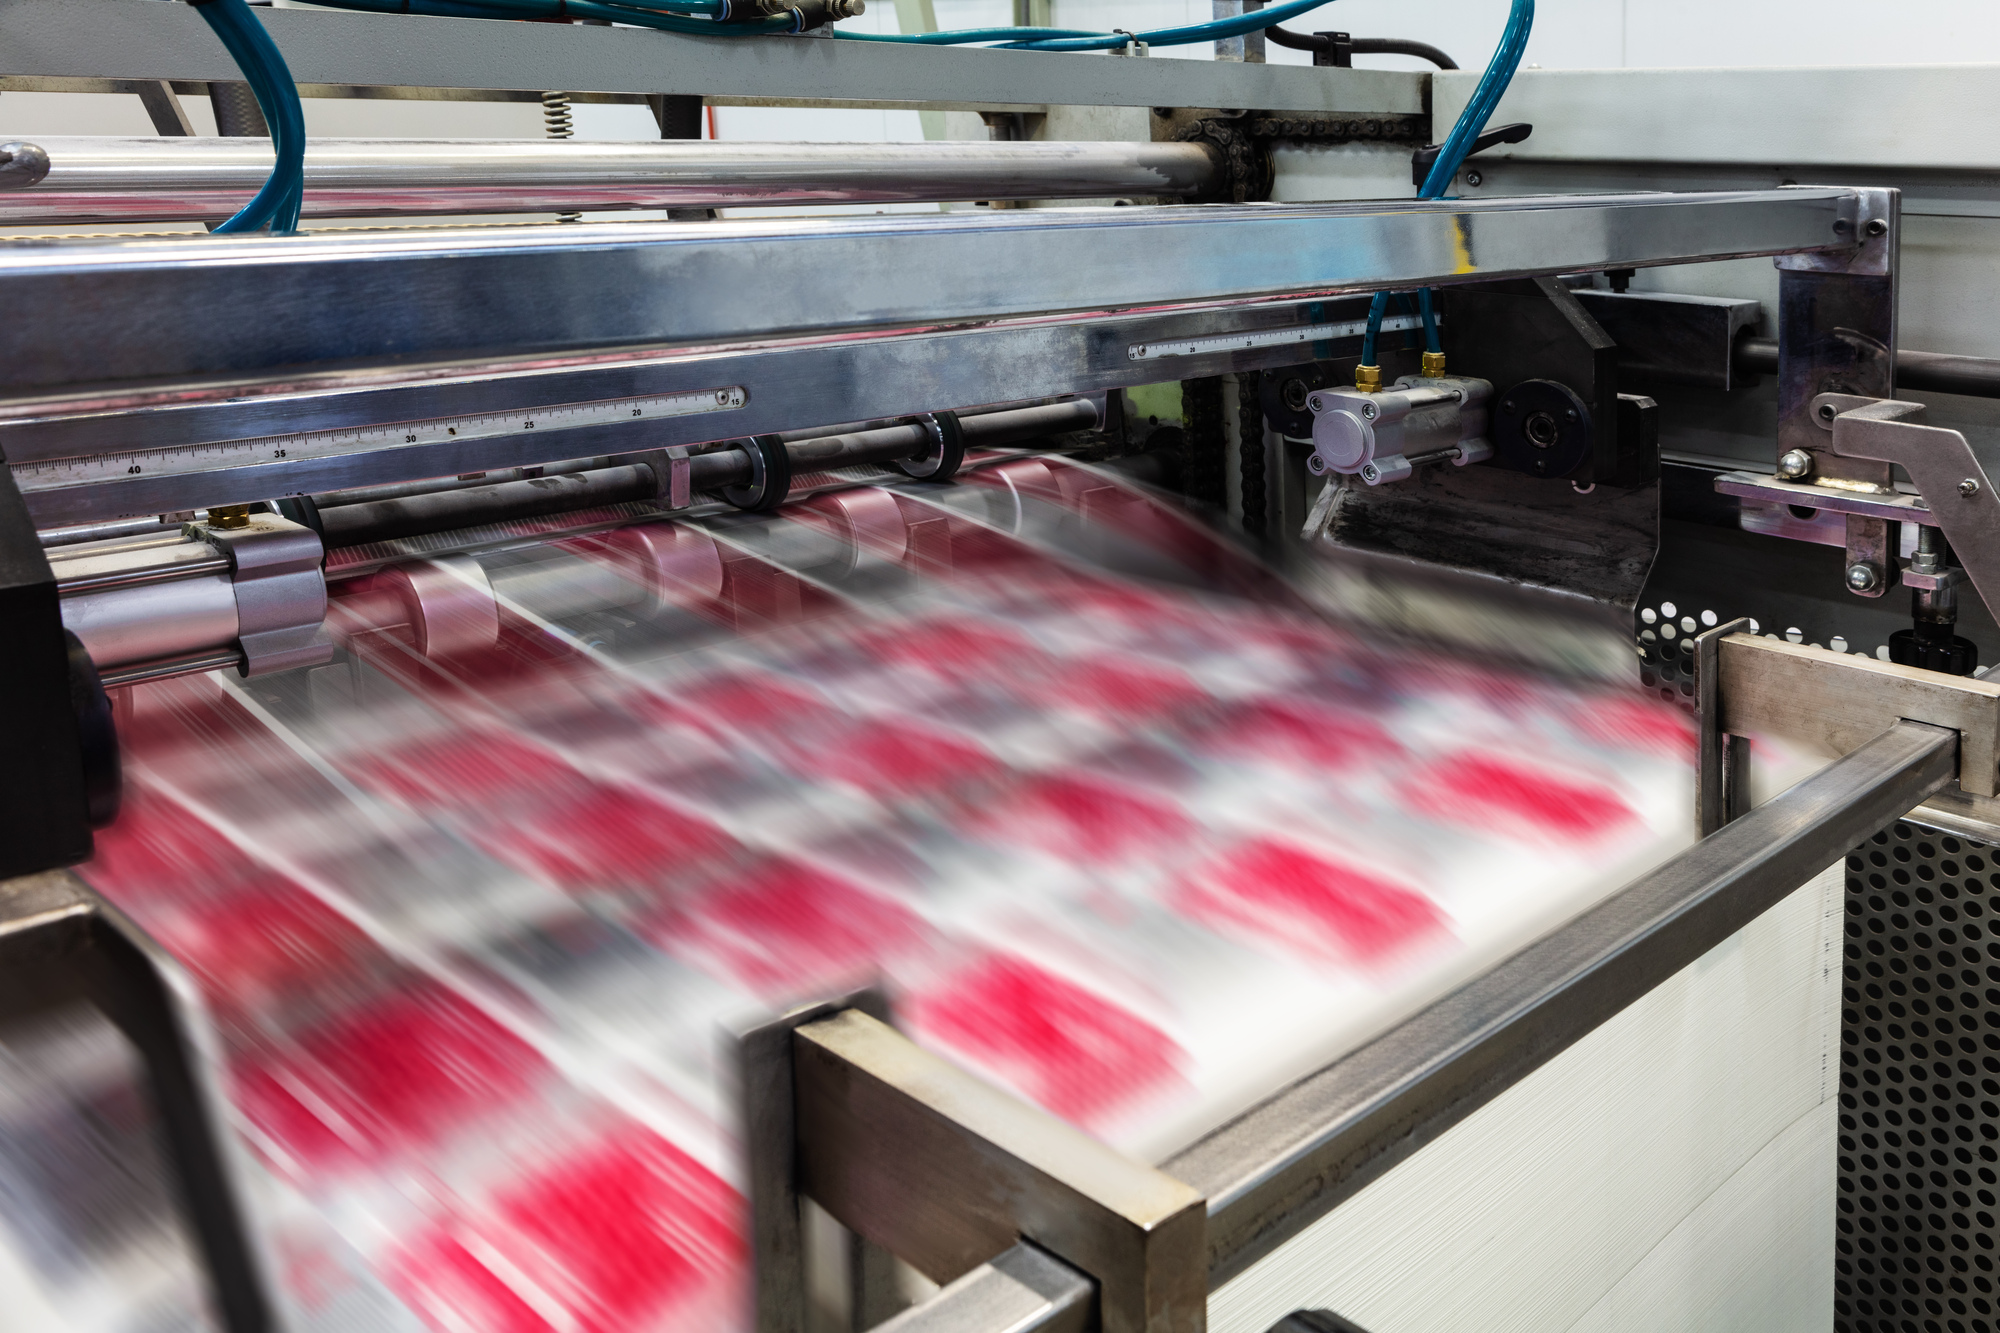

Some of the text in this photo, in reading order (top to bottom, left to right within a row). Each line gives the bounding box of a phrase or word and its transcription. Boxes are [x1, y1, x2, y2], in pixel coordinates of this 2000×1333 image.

[128, 465, 141, 474] 40
[274, 449, 286, 458] 35
[405, 434, 416, 443] 30
[524, 421, 534, 429] 25
[632, 408, 641, 416] 20
